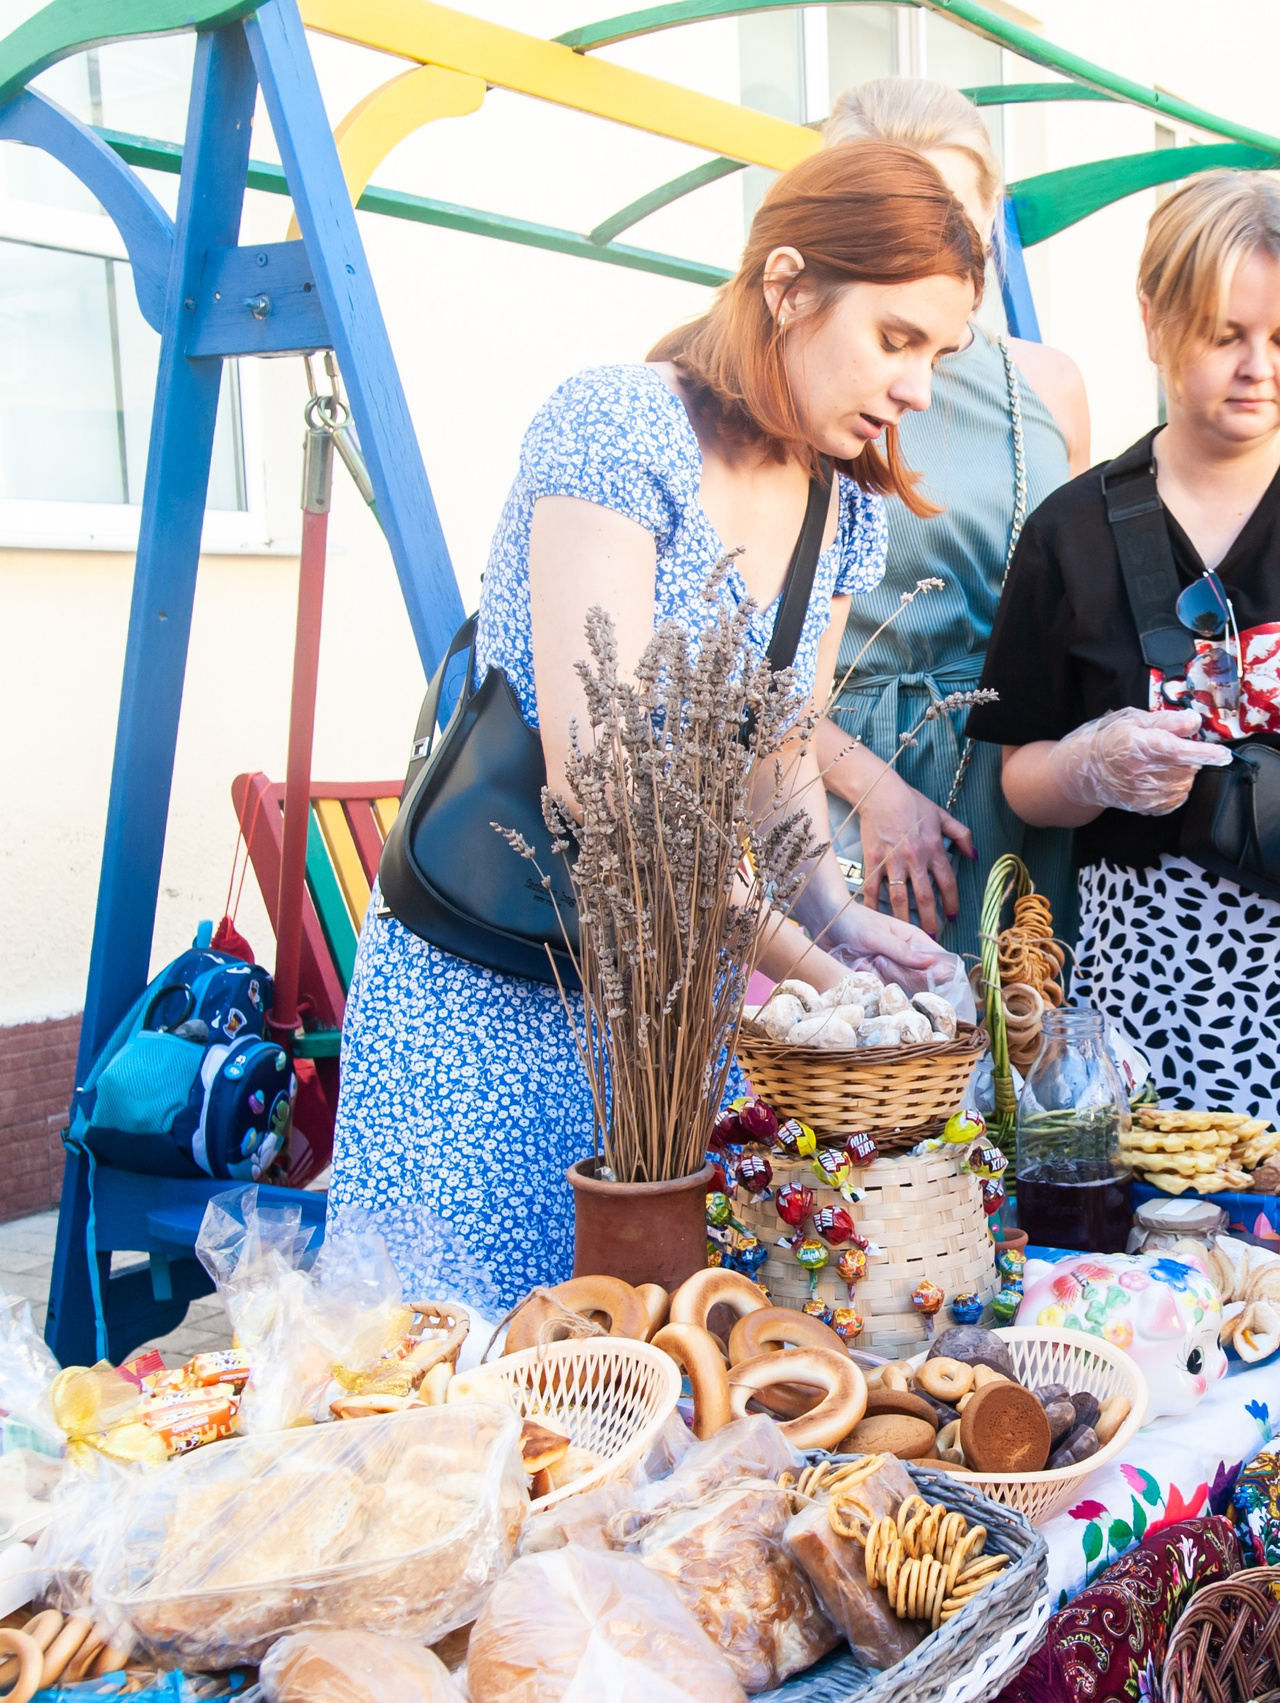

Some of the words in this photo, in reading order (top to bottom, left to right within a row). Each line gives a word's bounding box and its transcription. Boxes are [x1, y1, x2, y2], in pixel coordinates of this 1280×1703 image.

[777, 1126, 795, 1145] BAR
[784, 1119, 803, 1137] MIX
[850, 1132, 869, 1149] MIX
[857, 1140, 877, 1158] BAR
[819, 1152, 837, 1172] MIX
[983, 1147, 1003, 1161] BAR
[741, 1159, 755, 1178] BAR
[751, 1155, 766, 1172] MIX
[991, 1158, 1009, 1171] MIX
[821, 1208, 833, 1228] MIX
